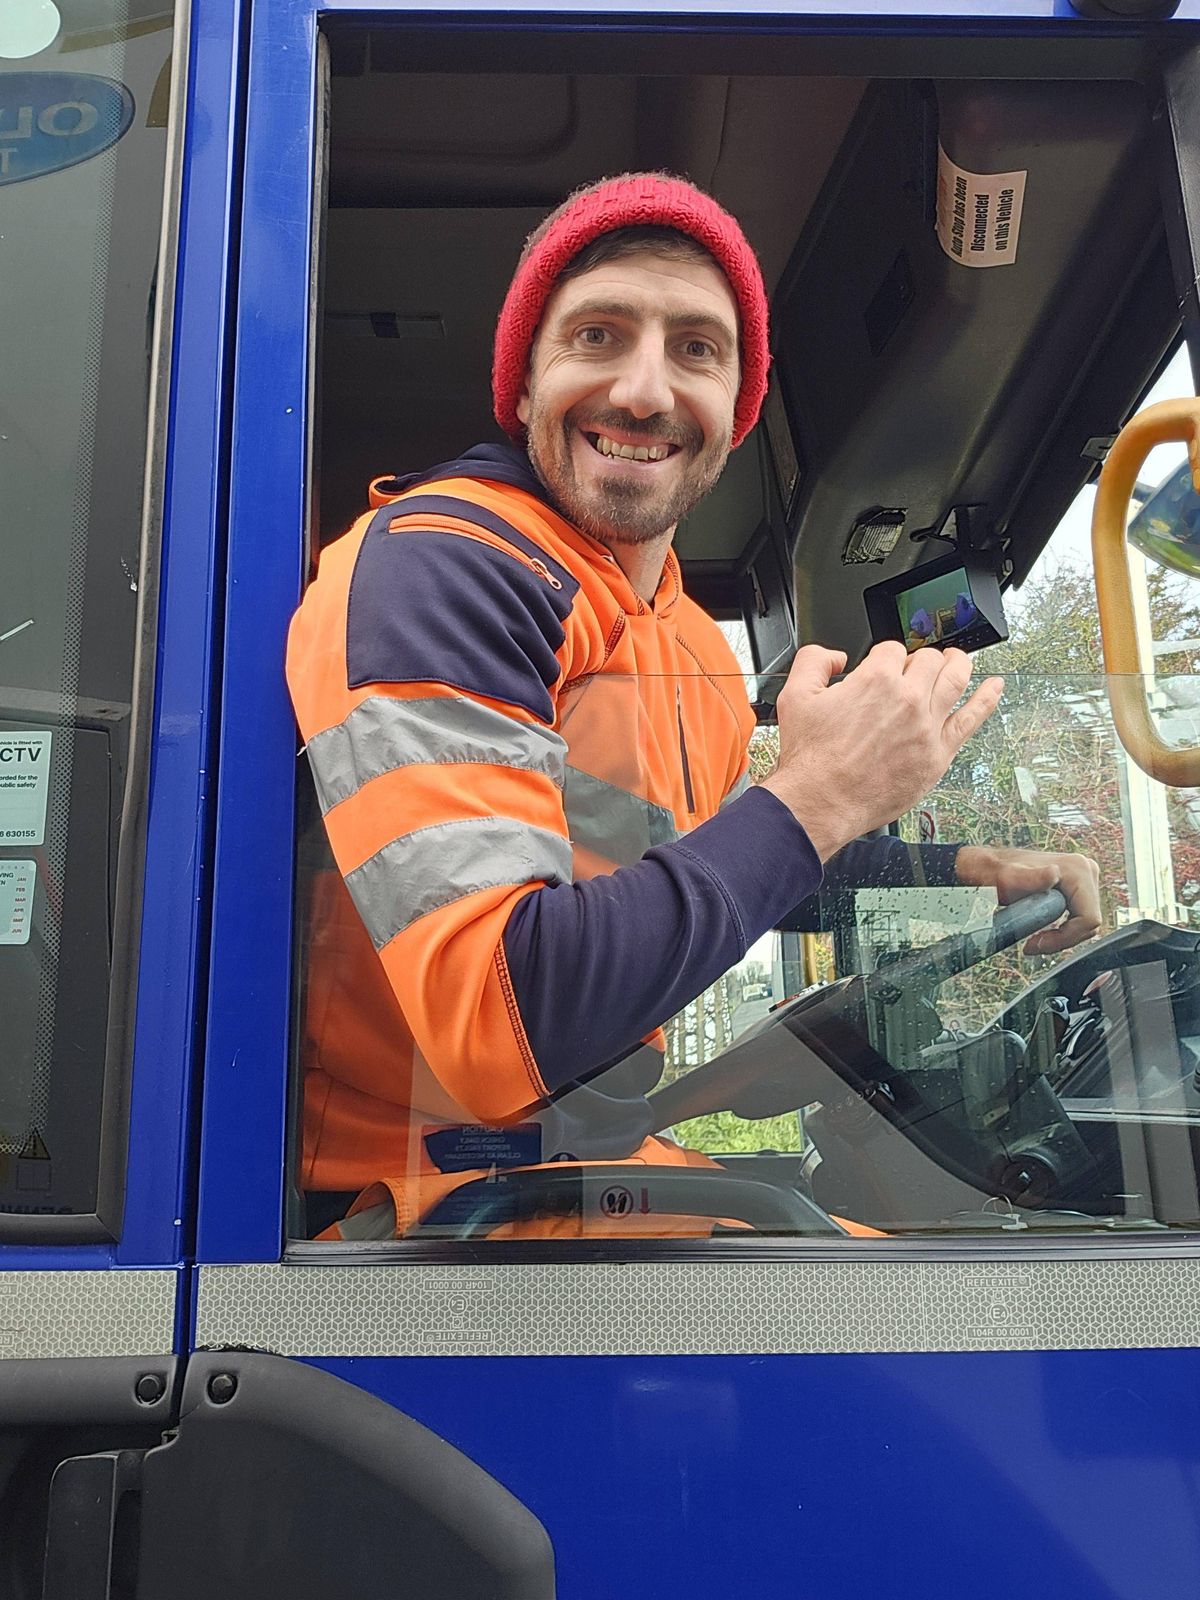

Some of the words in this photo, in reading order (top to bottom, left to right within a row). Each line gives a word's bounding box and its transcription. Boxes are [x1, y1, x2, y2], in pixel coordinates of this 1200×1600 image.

[954, 176, 968, 201] been
[953, 200, 966, 218] has
[996, 189, 1014, 223] Vehicle
[951, 217, 966, 237] Stop
[970, 194, 989, 252] Disconnected
[994, 223, 1010, 240] this
[951, 237, 963, 257] Auto
[995, 240, 1008, 251] on
[6, 830, 36, 838] 630155
[429, 1281, 449, 1289] 0001
[451, 1281, 462, 1289] 00
[972, 1328, 993, 1337] 104R
[997, 1328, 1008, 1337] 00
[1010, 1328, 1029, 1337] 0001
